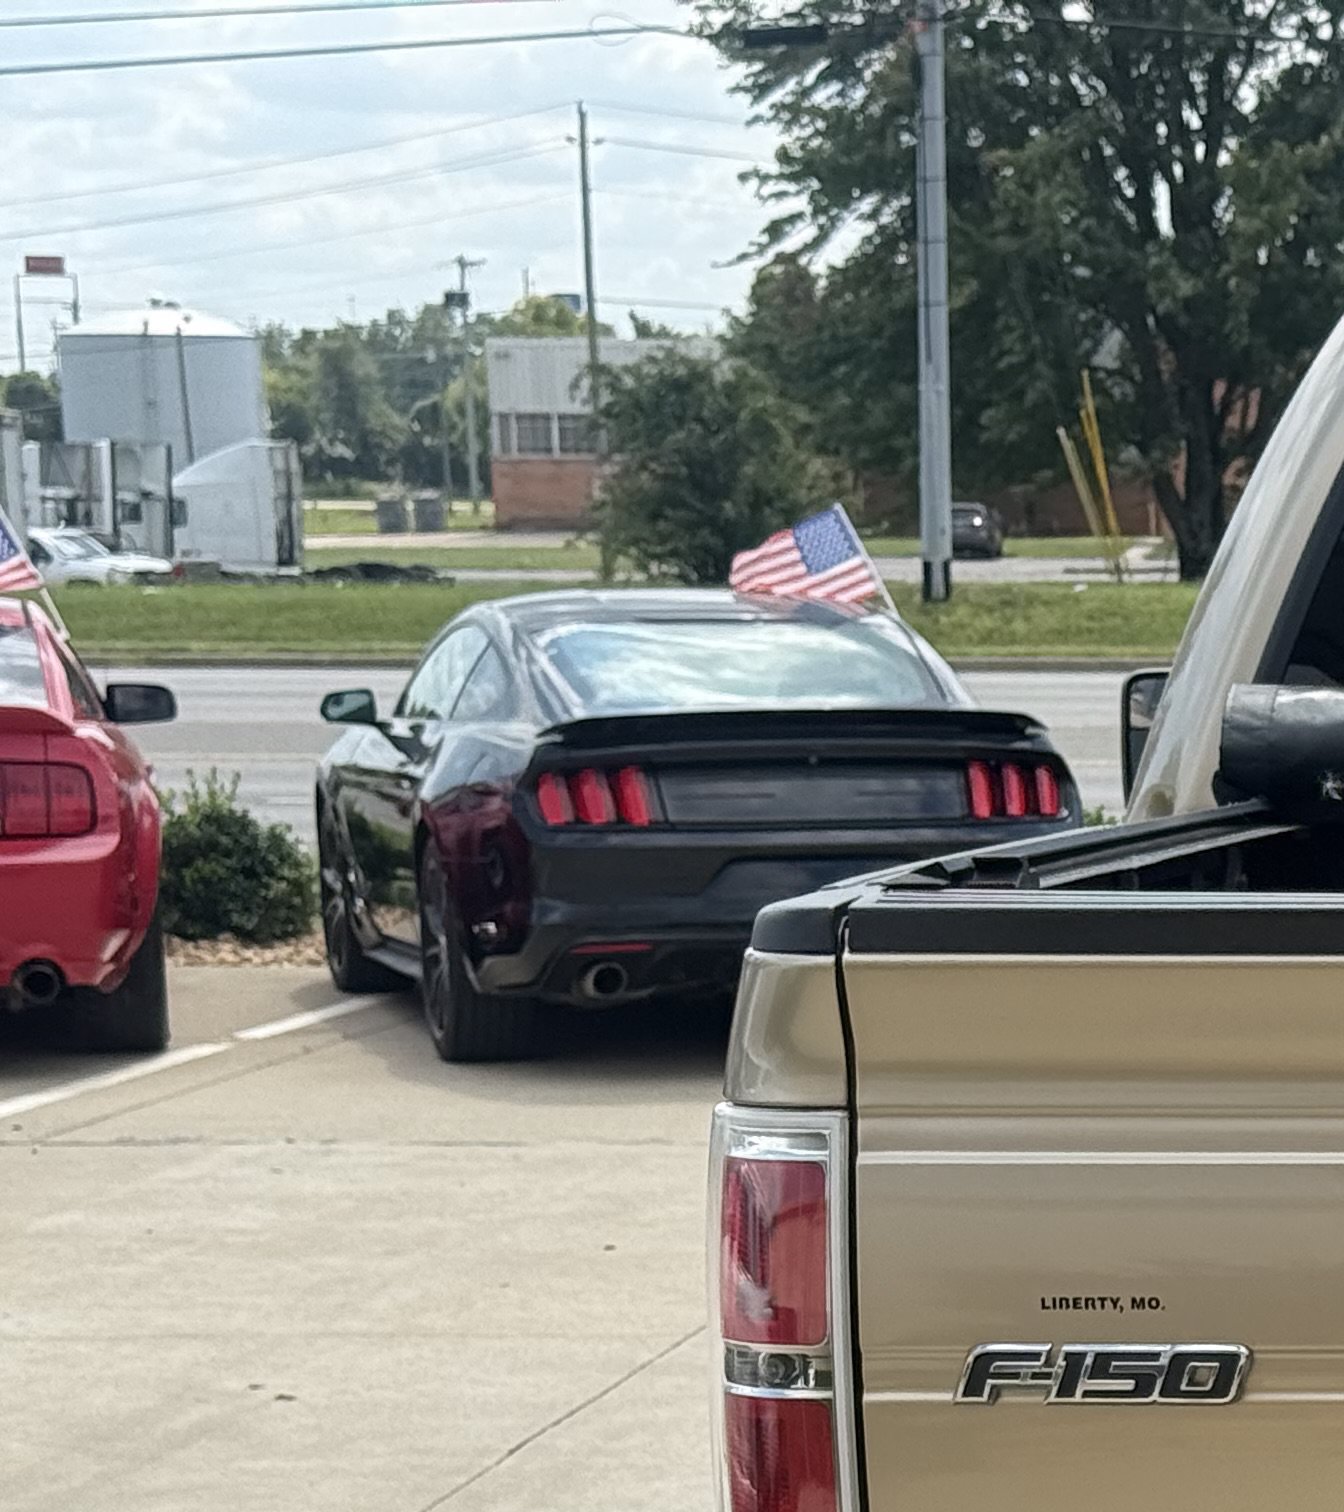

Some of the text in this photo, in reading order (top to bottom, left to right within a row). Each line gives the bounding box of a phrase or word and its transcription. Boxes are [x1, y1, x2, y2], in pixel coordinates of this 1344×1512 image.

[1040, 1296, 1166, 1313] LIBERTY, MO.
[953, 1342, 1253, 1405] F-150
